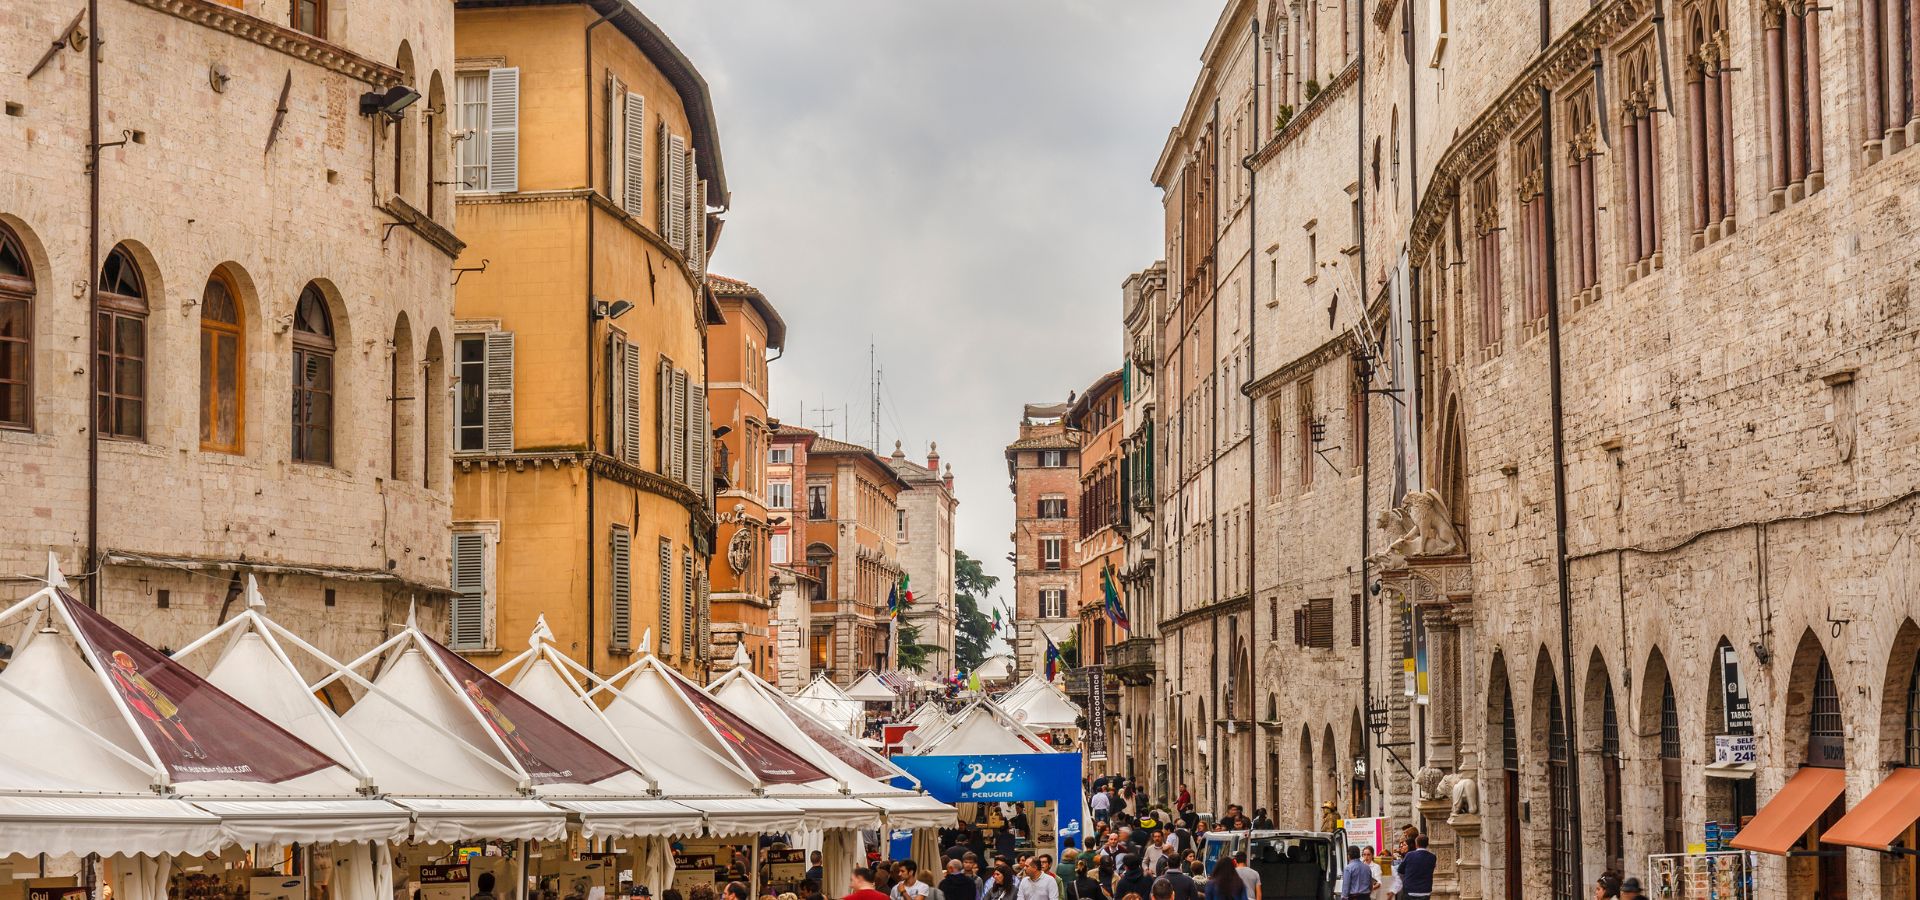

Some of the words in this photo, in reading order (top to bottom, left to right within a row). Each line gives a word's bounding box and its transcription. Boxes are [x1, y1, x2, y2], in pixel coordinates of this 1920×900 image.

[1093, 674, 1101, 727] chocodance
[1734, 752, 1757, 762] 24h
[960, 763, 1015, 789] Baci
[422, 868, 437, 876] Qui
[31, 891, 49, 900] Qui
